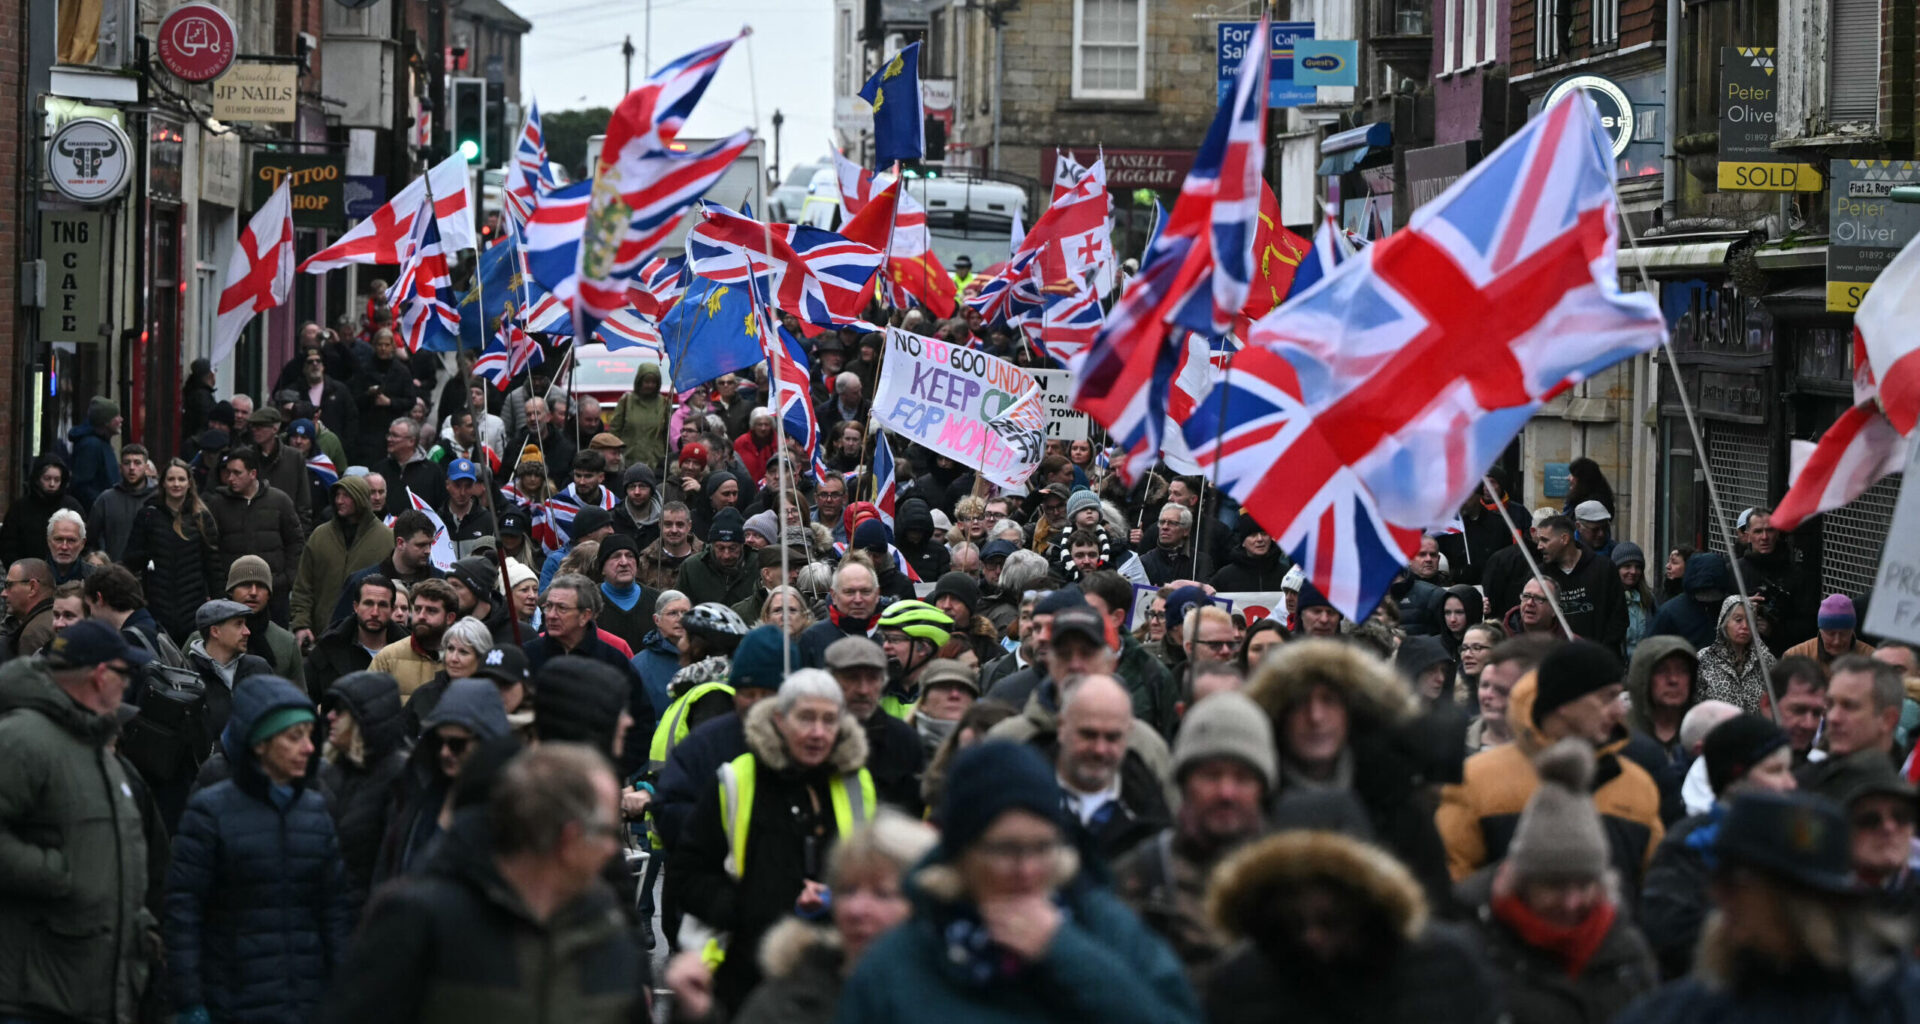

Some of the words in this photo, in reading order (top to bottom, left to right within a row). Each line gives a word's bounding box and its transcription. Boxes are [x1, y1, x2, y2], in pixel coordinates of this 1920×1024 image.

[1222, 26, 1252, 43] For
[161, 39, 170, 57] BUY
[167, 57, 182, 73] AND
[183, 69, 203, 79] SELL
[204, 64, 220, 77] FOR
[219, 41, 231, 65] CASH
[1222, 44, 1249, 60] Sal
[216, 85, 238, 100] JP
[241, 86, 292, 101] NAILS
[1728, 82, 1771, 100] Peter
[1600, 115, 1632, 128] SH
[260, 164, 338, 193] TTTOO
[1736, 166, 1797, 187] SOLD
[1850, 183, 1865, 194] Flat
[292, 194, 329, 210] HOP
[1837, 197, 1885, 216] Peter
[51, 221, 89, 244] TN6
[1837, 220, 1897, 241] Oliver
[1859, 251, 1884, 260] 01892
[62, 252, 78, 332] CAFE
[894, 330, 922, 357] NO
[921, 338, 949, 364] TO
[950, 348, 986, 378] 600
[910, 361, 981, 412] KEEP
[888, 397, 945, 438] FOR
[1049, 408, 1084, 419] TOWN
